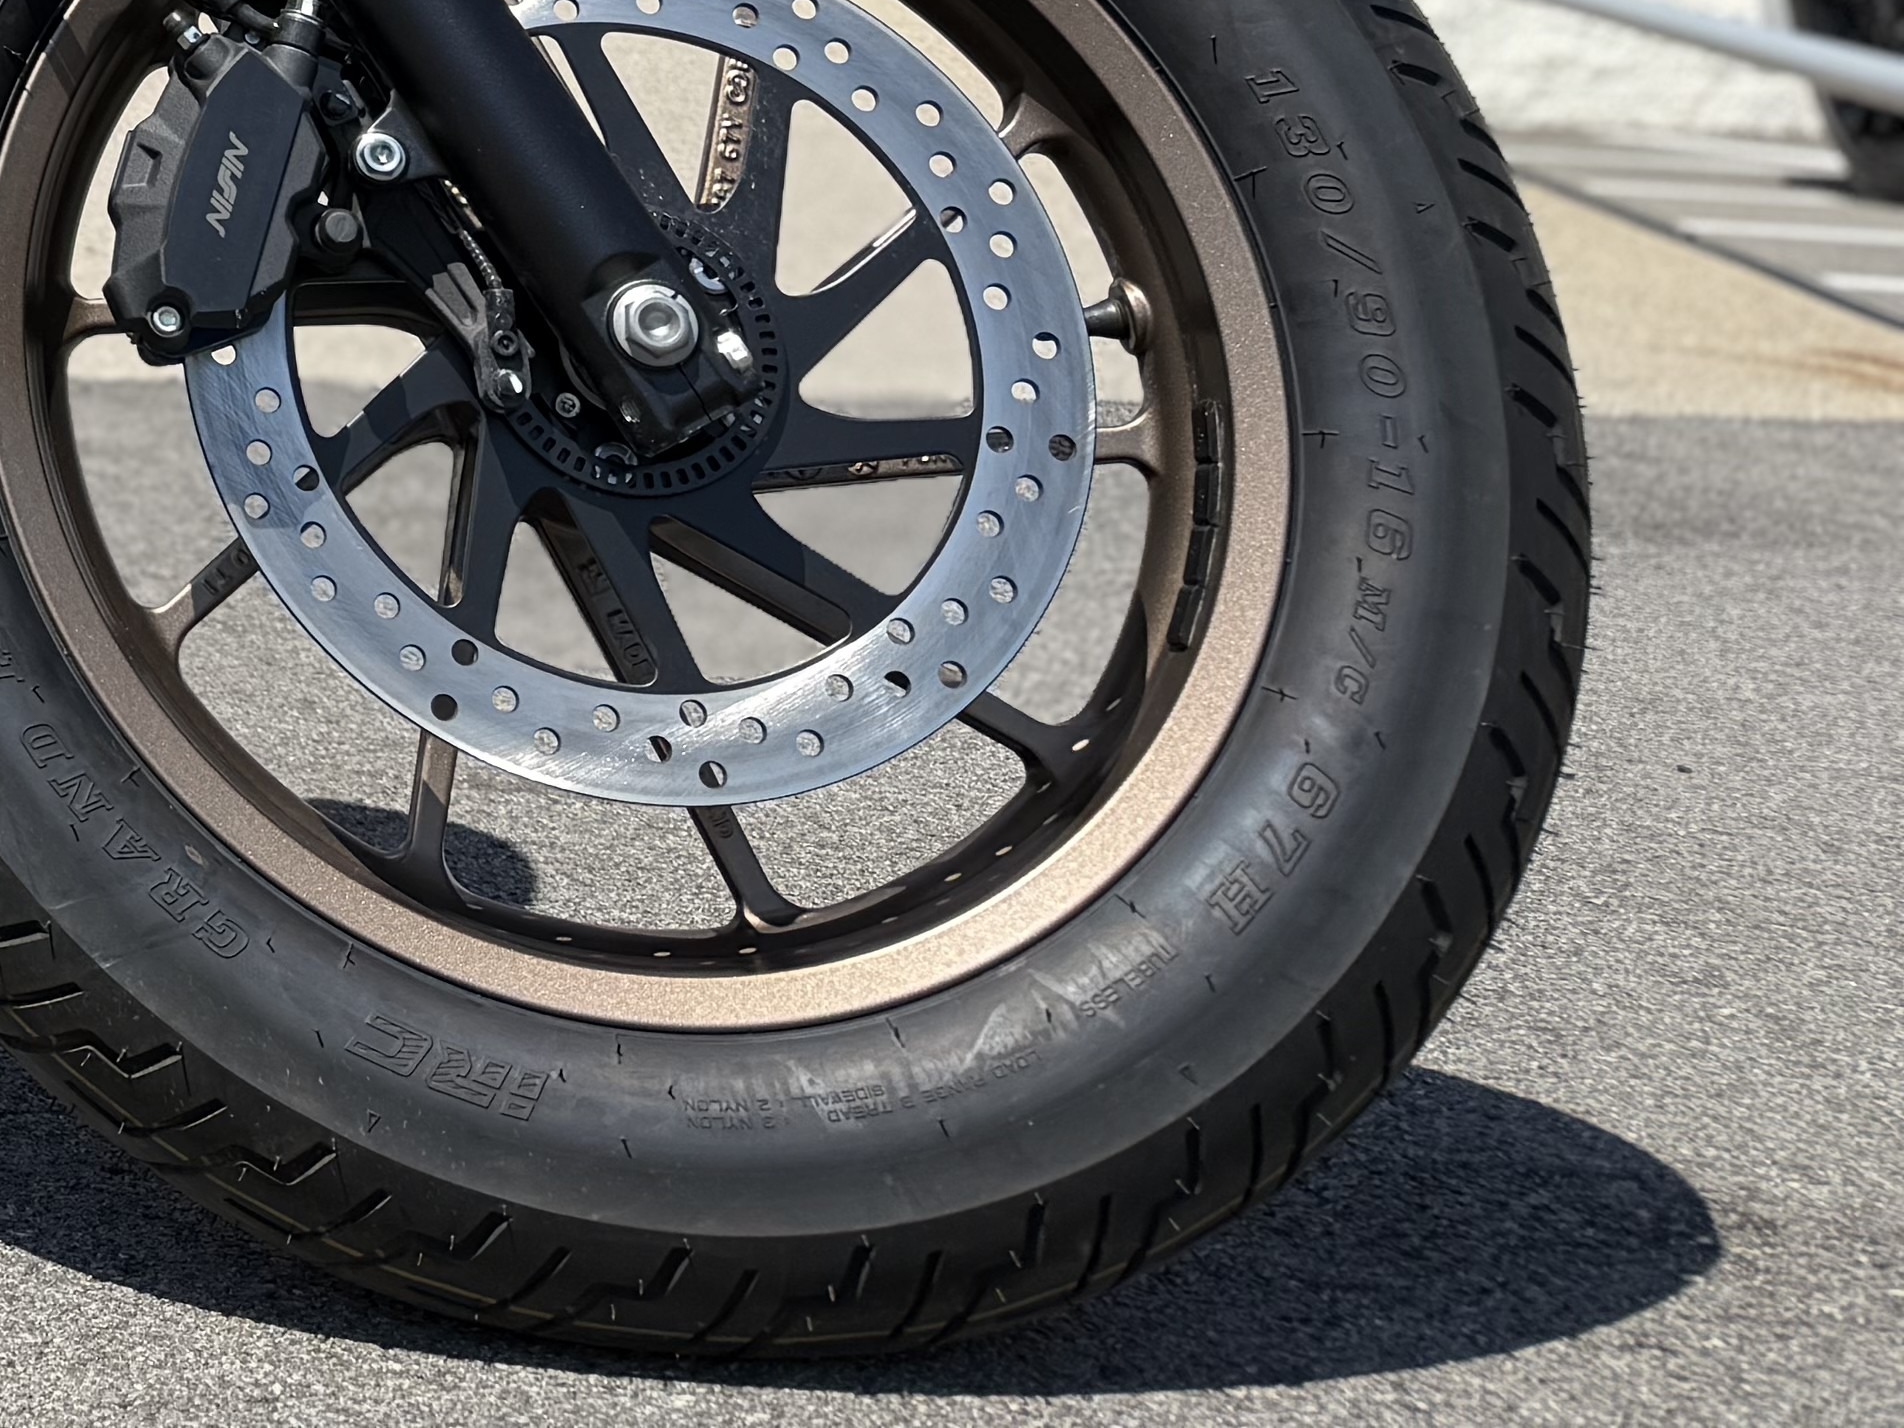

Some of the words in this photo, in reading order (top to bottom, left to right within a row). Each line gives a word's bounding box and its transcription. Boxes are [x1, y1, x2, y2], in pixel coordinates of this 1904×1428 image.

[1245, 67, 1415, 562] 130/90-16
[1335, 577, 1392, 704] M/C
[20, 723, 250, 960] GRAND
[1207, 763, 1339, 935] 67H
[1079, 942, 1179, 1017] TUBELESS
[991, 1050, 1042, 1081] LOAD
[683, 1099, 750, 1114] NYLON
[757, 1099, 772, 1112] 2
[792, 1084, 886, 1109] SIDEWALL
[686, 1116, 753, 1130] NYLON
[827, 1105, 894, 1124] TREAD
